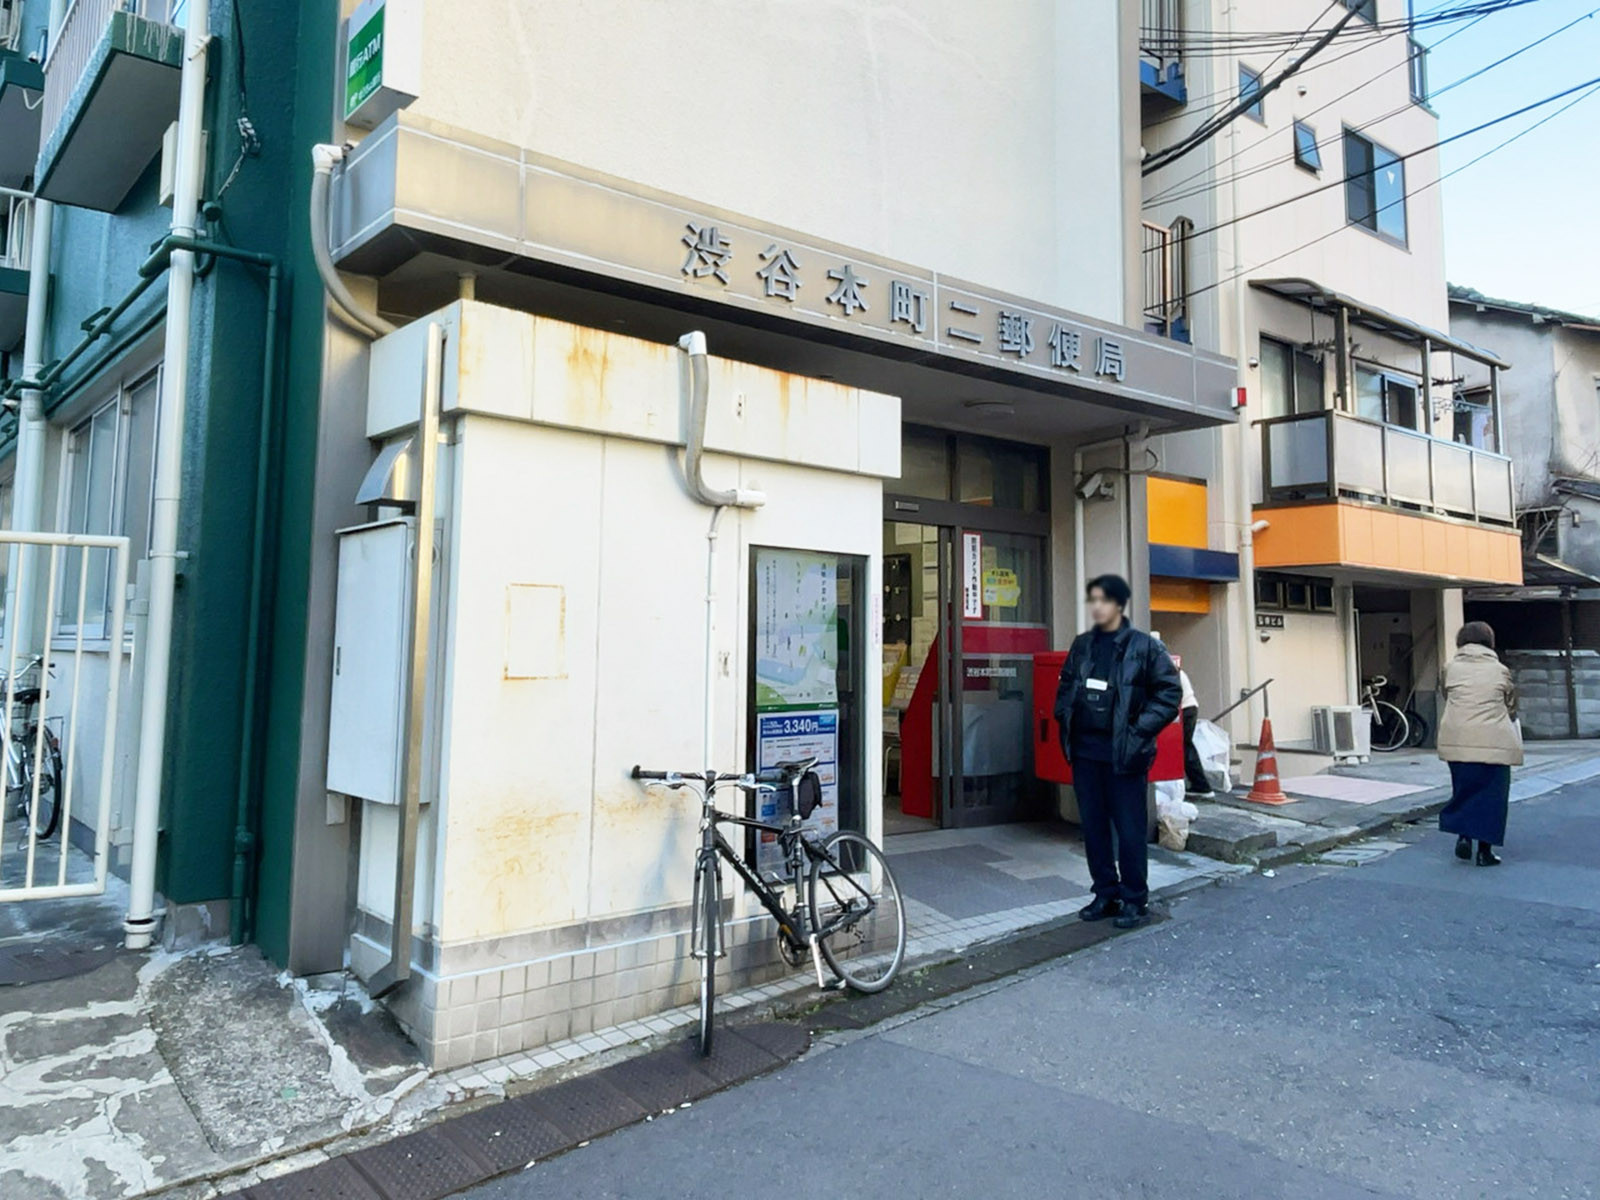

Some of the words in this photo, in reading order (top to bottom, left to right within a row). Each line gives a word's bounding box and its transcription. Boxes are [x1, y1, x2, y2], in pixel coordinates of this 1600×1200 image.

[681, 222, 1128, 383] 渋谷本町二郵便局
